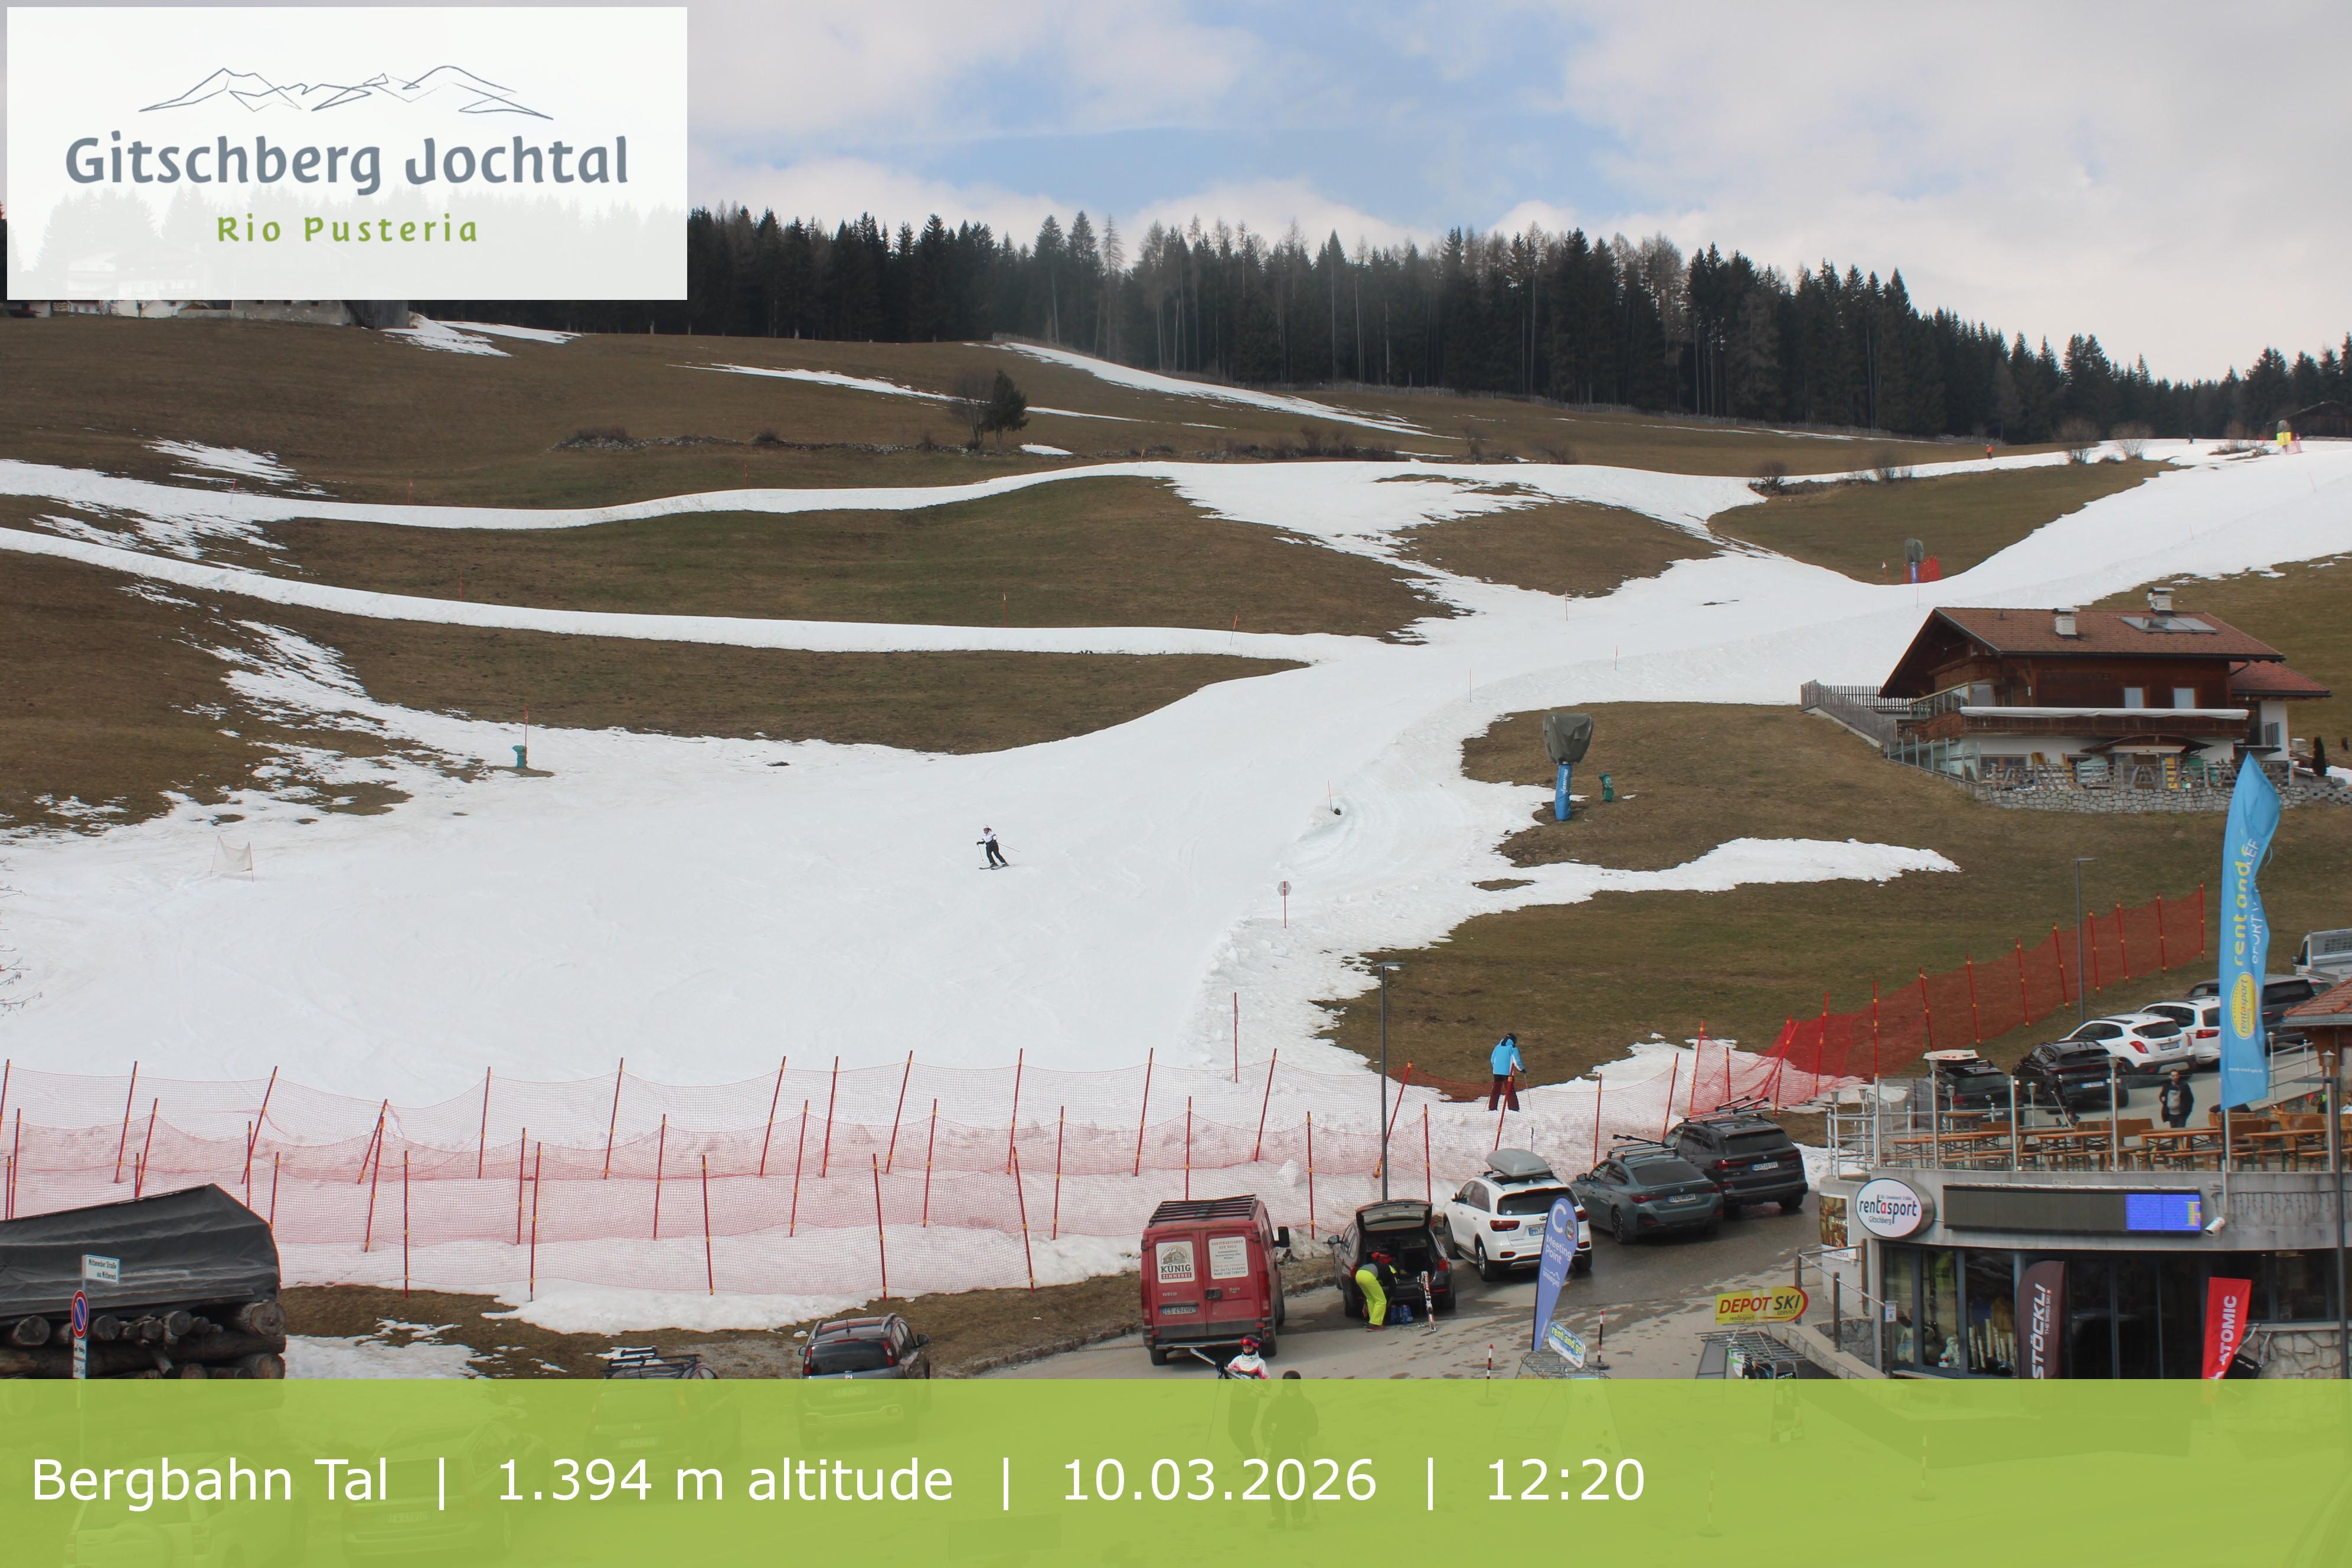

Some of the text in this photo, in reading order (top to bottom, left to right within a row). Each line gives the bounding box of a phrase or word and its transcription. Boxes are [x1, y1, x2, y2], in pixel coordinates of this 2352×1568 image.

[2235, 860, 2250, 909] and
[2234, 914, 2248, 966] rent
[2240, 978, 2249, 1033] rentasport
[1551, 1203, 1567, 1233] C
[1859, 1194, 1917, 1224] rentasport
[1868, 1216, 1892, 1225] Gitschberg
[1545, 1244, 1562, 1265] Point
[1546, 1234, 1572, 1261] Meeting
[1161, 1264, 1191, 1273] KÜNIG
[1719, 1295, 1801, 1314] DEPOT SKI
[1551, 1326, 1564, 1340] rent
[1564, 1335, 1575, 1348] and
[1575, 1344, 1582, 1355] go
[2030, 1283, 2047, 1379] STÖCKLI
[2219, 1295, 2237, 1366] ATOMIC
